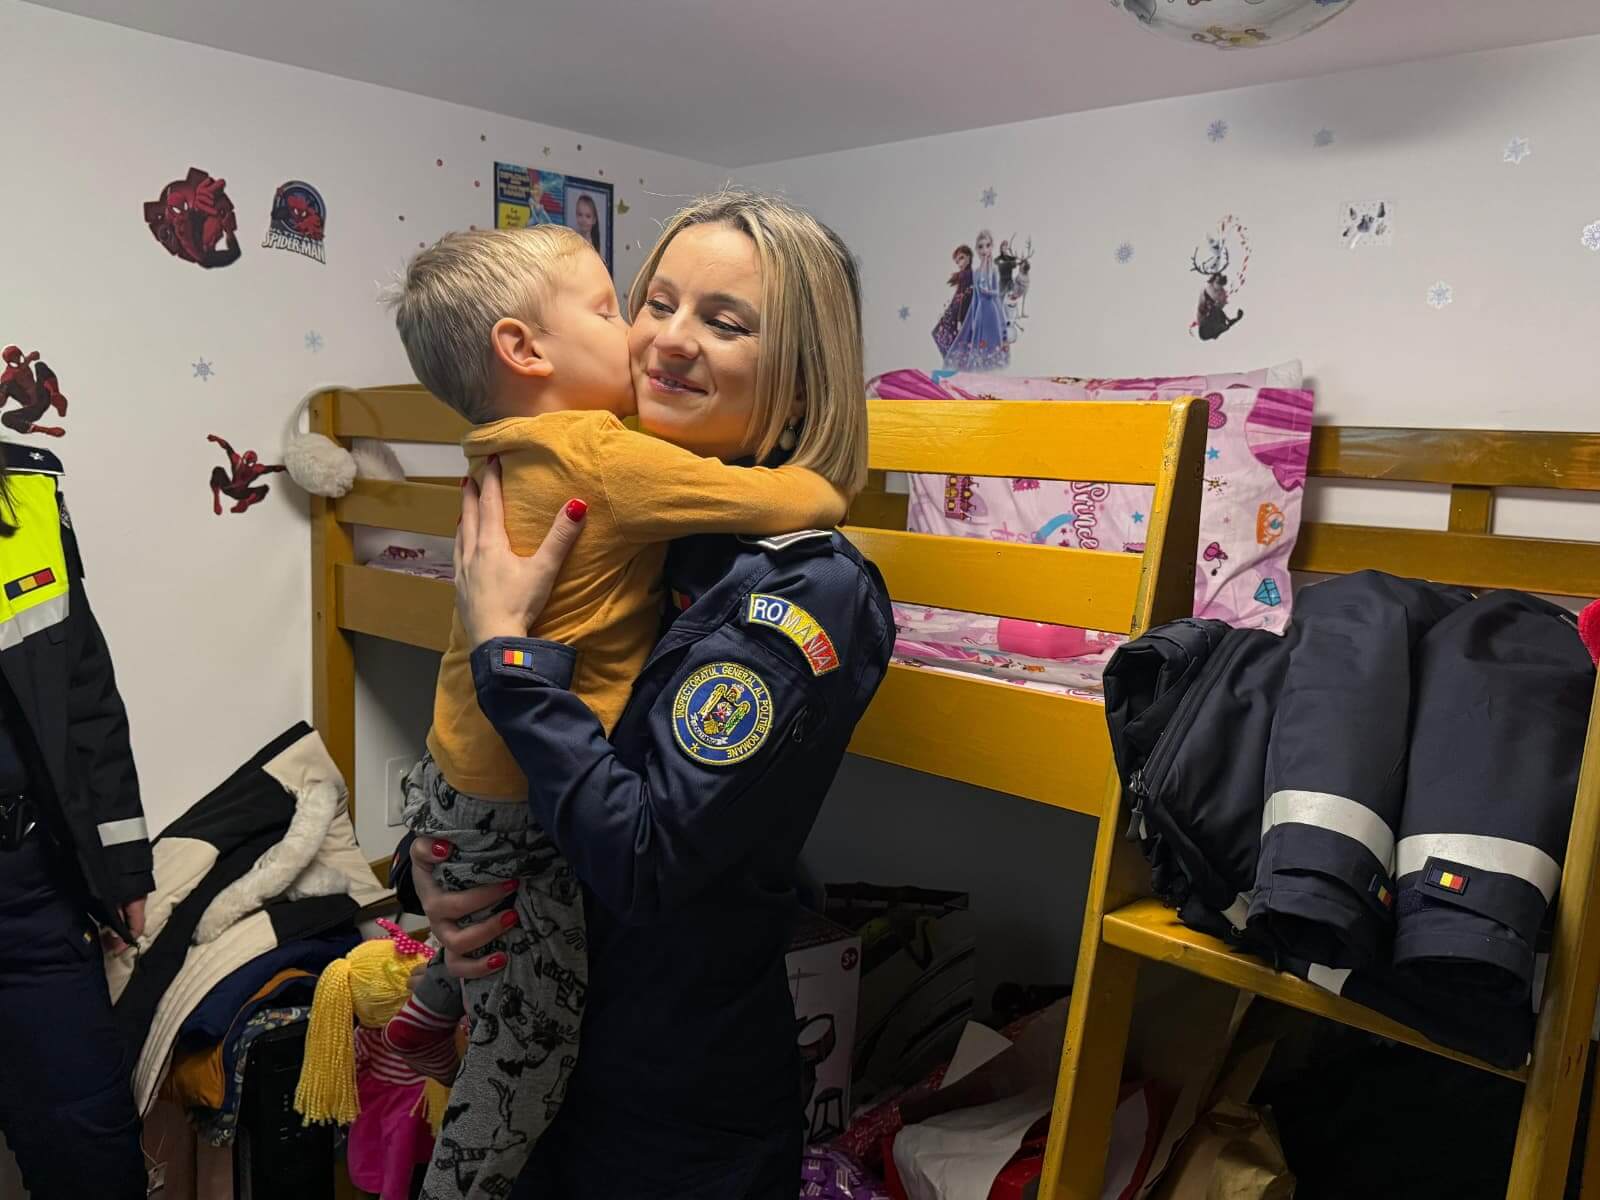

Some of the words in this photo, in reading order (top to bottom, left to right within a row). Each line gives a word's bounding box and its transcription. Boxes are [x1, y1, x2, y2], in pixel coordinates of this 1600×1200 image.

[676, 666, 720, 718] INSPECTORATUL
[721, 666, 756, 689] GENERAL
[754, 686, 767, 699] AL
